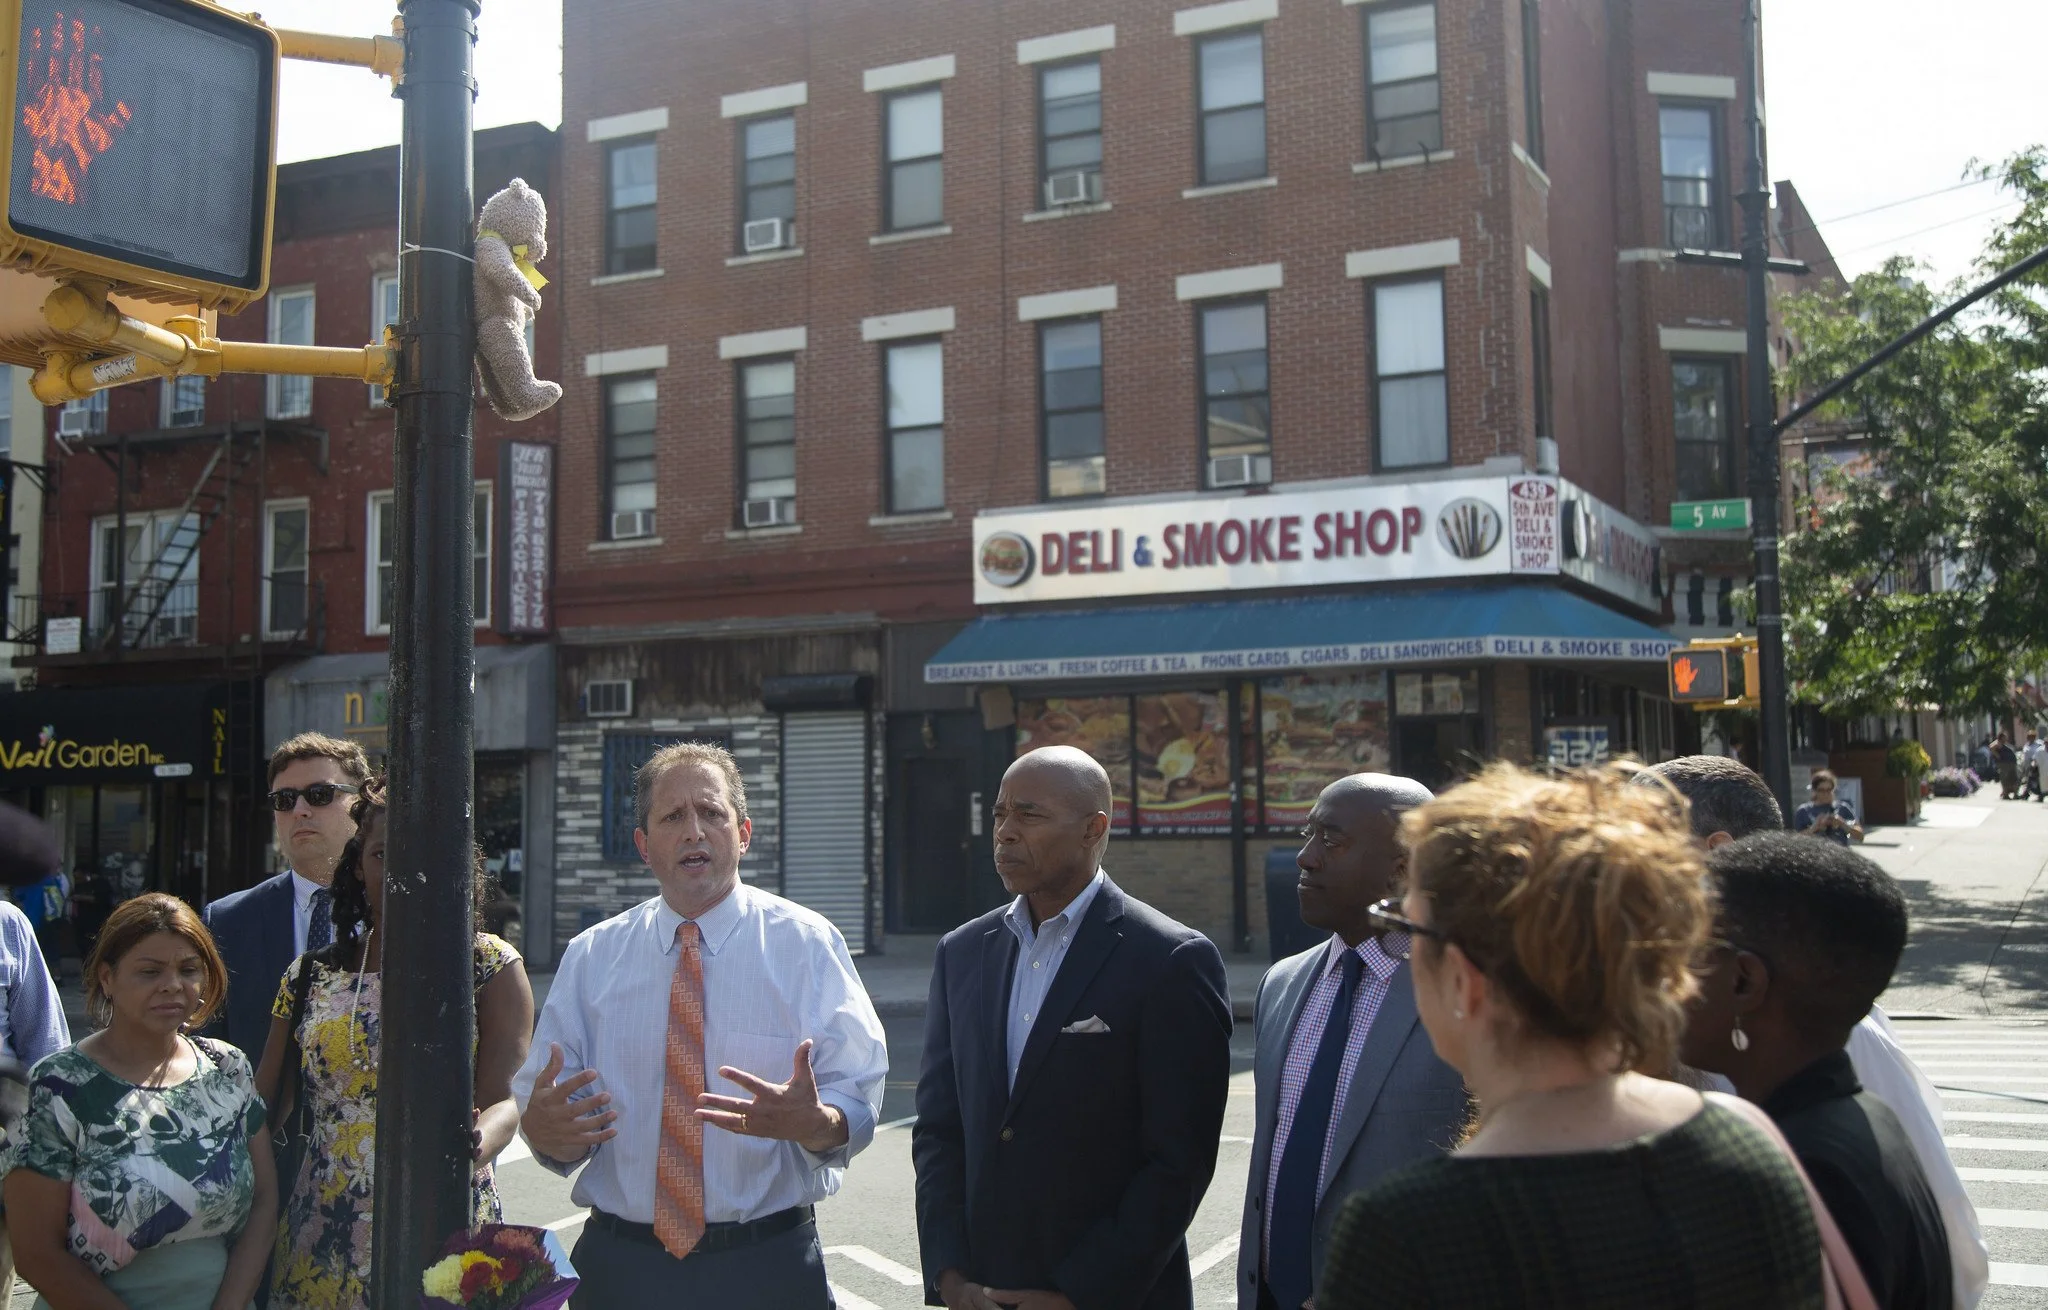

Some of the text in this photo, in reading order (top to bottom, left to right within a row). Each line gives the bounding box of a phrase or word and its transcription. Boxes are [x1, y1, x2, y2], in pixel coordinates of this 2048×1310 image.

[1519, 481, 1548, 499] 439
[1513, 502, 1554, 517] 5th AVE
[1693, 506, 1704, 528] 5
[1516, 519, 1551, 533] DELI &
[1041, 506, 1422, 575] DELI & SMOKE SHOP
[1515, 536, 1554, 550] SMOKE
[1520, 553, 1550, 568] SHOP
[1494, 639, 1534, 654] DELI
[1542, 640, 1553, 654] &
[1559, 640, 1623, 656] SMOKE
[928, 639, 1484, 681] BREAKFAST & LUNCH FRESH COFFEE & TEA PHONE CARDS CIGARS DELI SANDWICHES
[212, 708, 226, 774] NAIL
[57, 738, 150, 769] Garden
